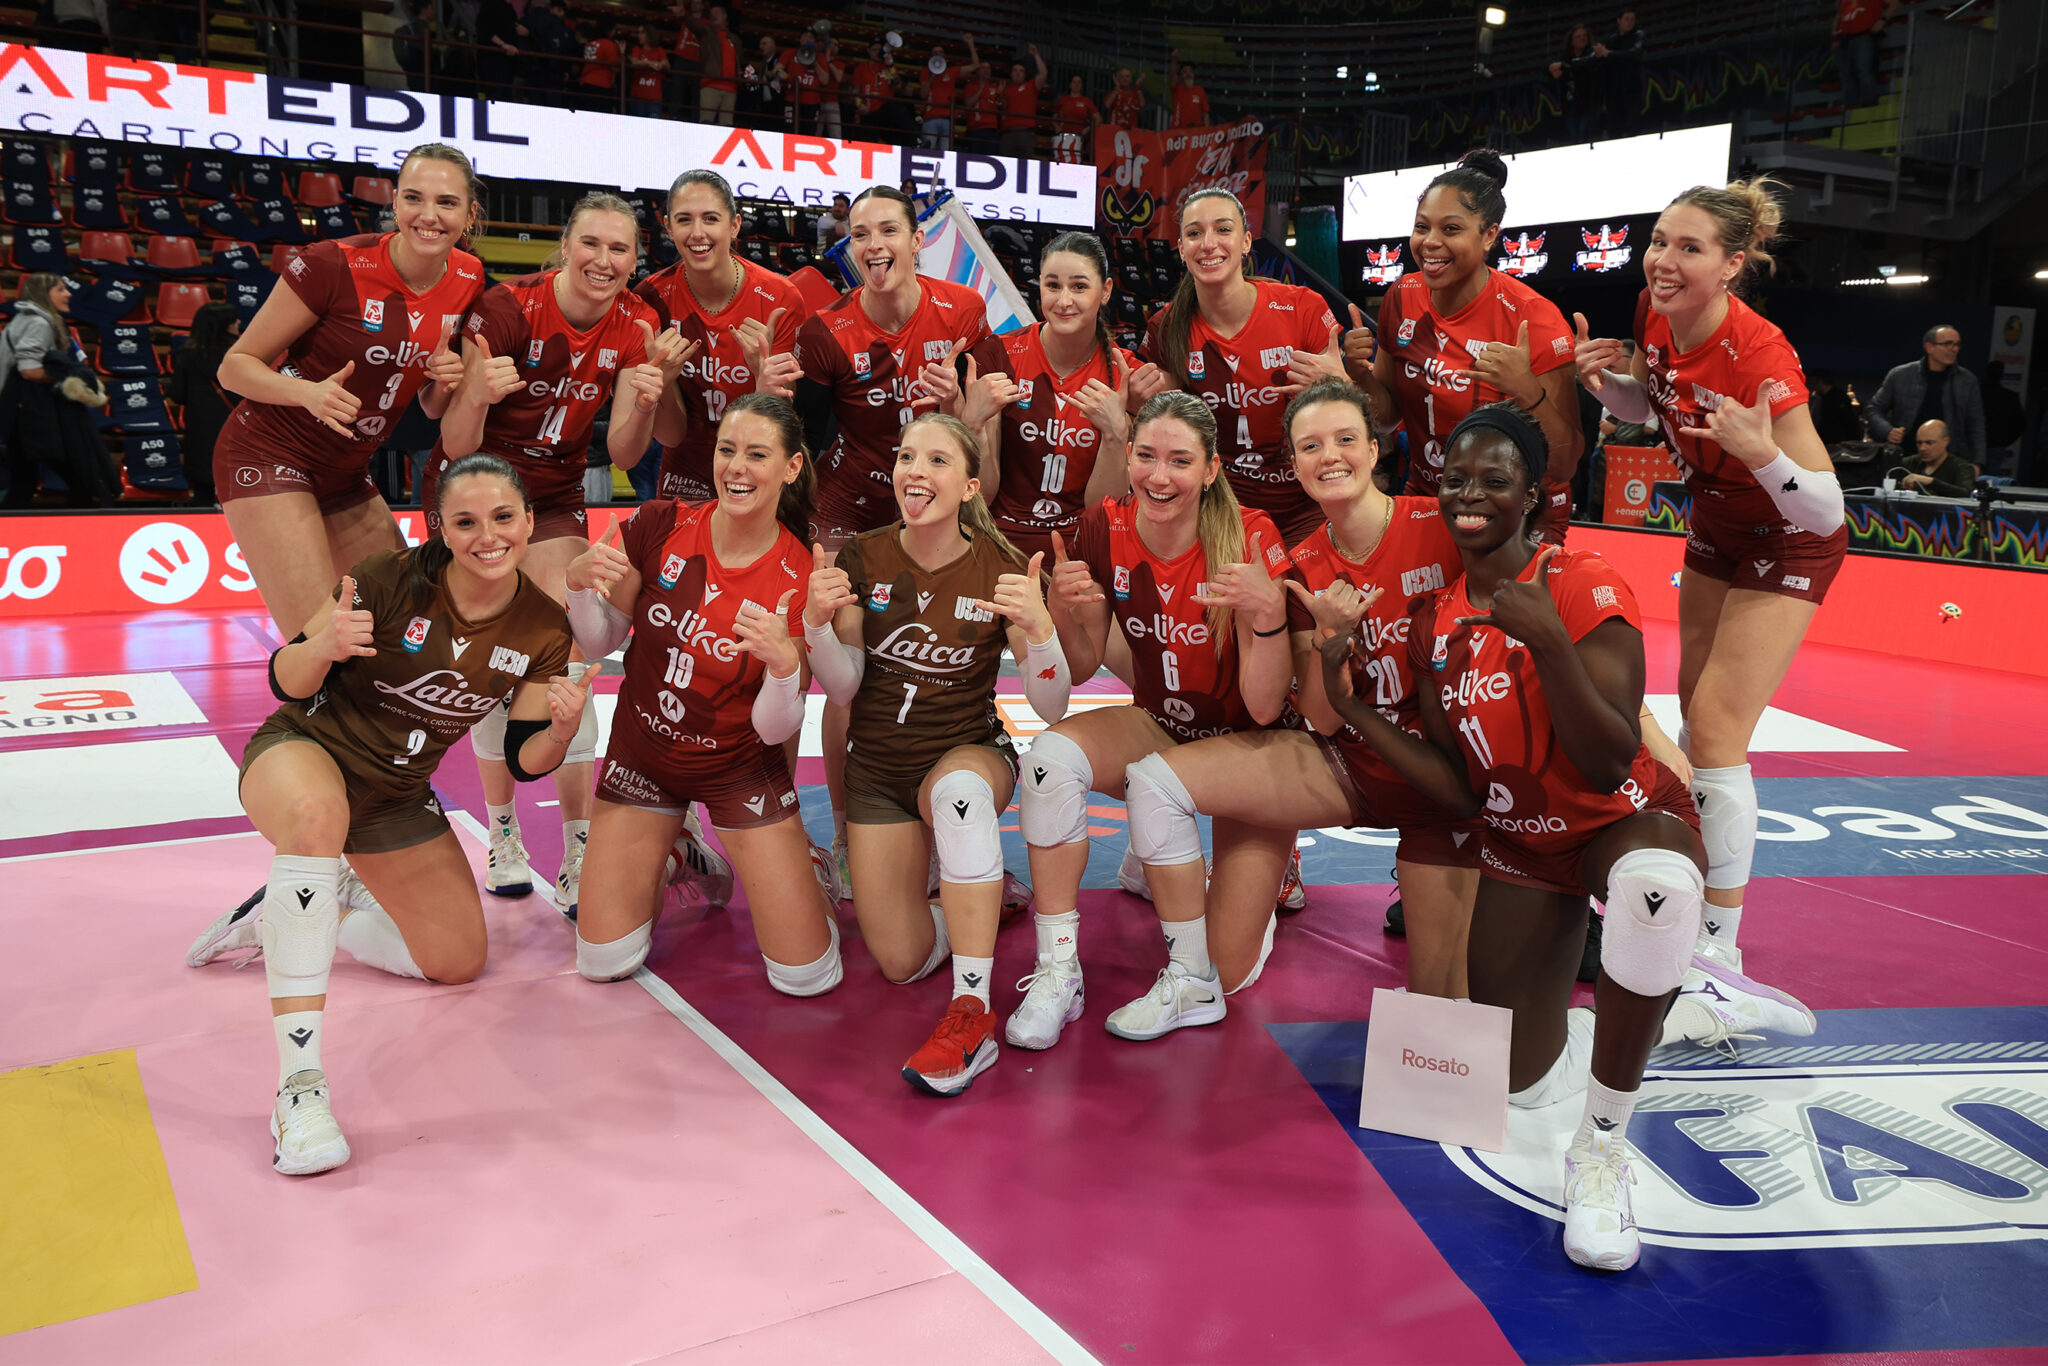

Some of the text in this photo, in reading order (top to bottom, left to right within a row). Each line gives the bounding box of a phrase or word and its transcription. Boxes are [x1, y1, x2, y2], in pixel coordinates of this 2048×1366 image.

[710, 127, 1078, 199] ARTEDIL
[456, 268, 478, 280] Ricola
[754, 285, 775, 302] Ricola
[1268, 301, 1295, 311] Ricola
[115, 328, 137, 337] C50
[123, 382, 146, 392] B50
[378, 372, 404, 410] 3
[702, 389, 728, 422] 12
[1424, 393, 1436, 436] 1
[536, 405, 569, 445] 14
[1236, 415, 1254, 449] 4
[141, 440, 164, 450] A50
[1040, 453, 1068, 494] 10
[1410, 509, 1439, 519] Ricola
[1401, 563, 1446, 597] UYBA
[488, 645, 531, 678] UYBA
[866, 623, 977, 673] Laica
[666, 646, 694, 690] 19
[1162, 650, 1180, 692] 6
[1365, 655, 1404, 705] 20
[373, 669, 501, 717] Laica
[379, 702, 407, 718] AMORE
[896, 682, 918, 725] 7
[1459, 716, 1493, 770] 11
[619, 781, 661, 803] FORMA
[1881, 847, 2048, 859] Internet
[1402, 1048, 1470, 1077] Rosato
